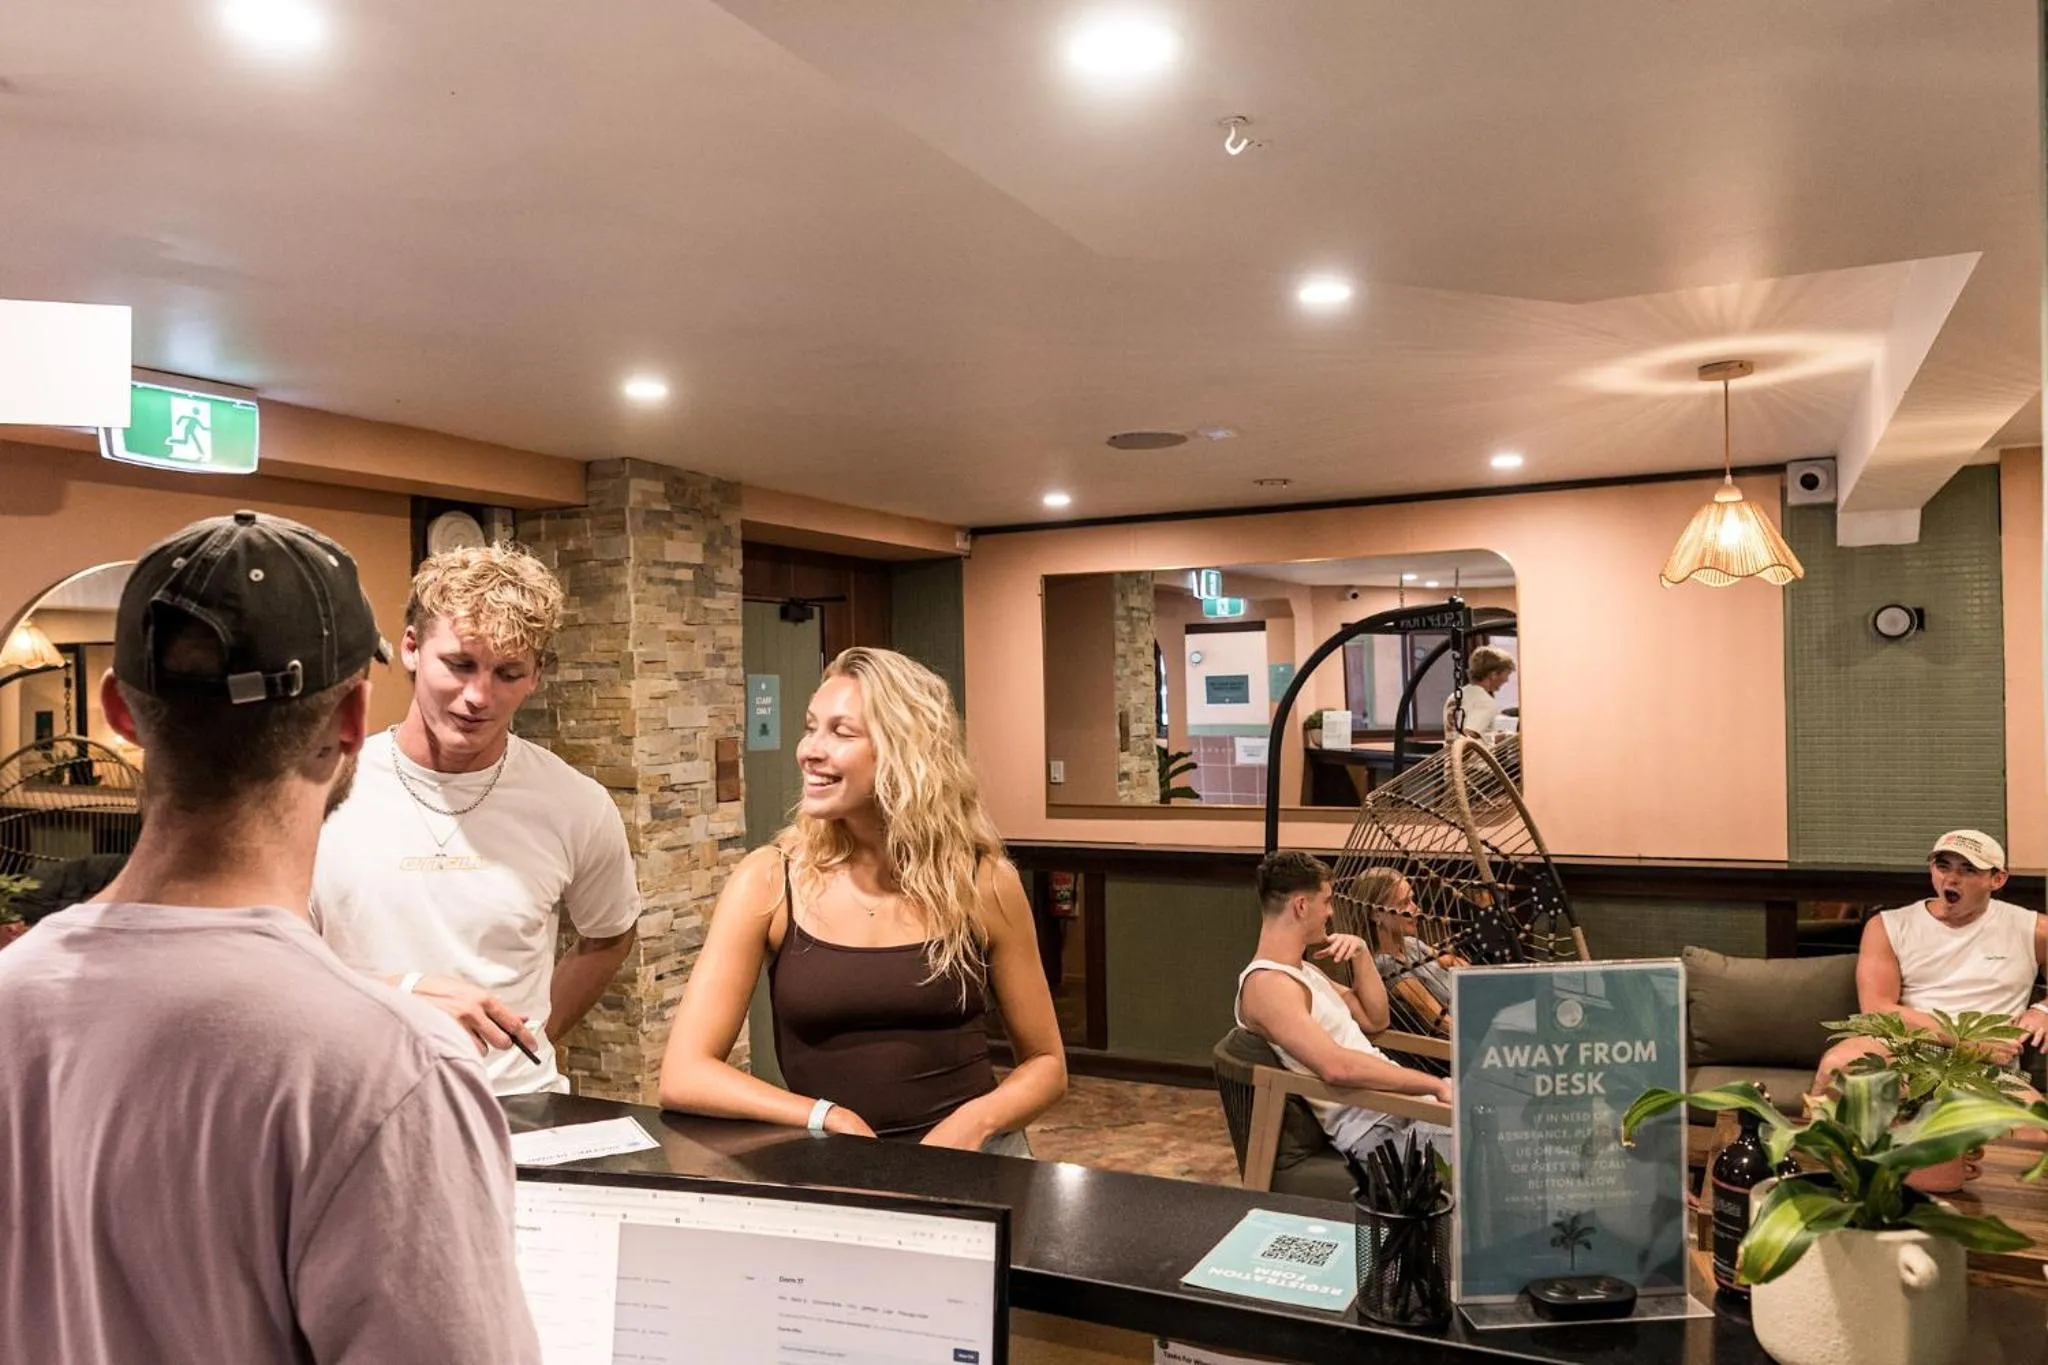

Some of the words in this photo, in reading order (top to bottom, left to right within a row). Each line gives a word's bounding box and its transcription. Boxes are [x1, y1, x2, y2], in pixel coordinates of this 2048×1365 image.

[756, 707, 771, 715] ONLY
[1482, 1044, 1571, 1069] AWAY
[1579, 1040, 1657, 1066] FROM
[1535, 1072, 1606, 1096] DESK
[1546, 1112, 1559, 1123] IN
[1561, 1111, 1592, 1122] NEED
[1534, 1144, 1552, 1157] ON
[1528, 1178, 1574, 1190] BUTTON
[1253, 1266, 1307, 1282] FORM
[1208, 1267, 1344, 1296] REGISTRATION
